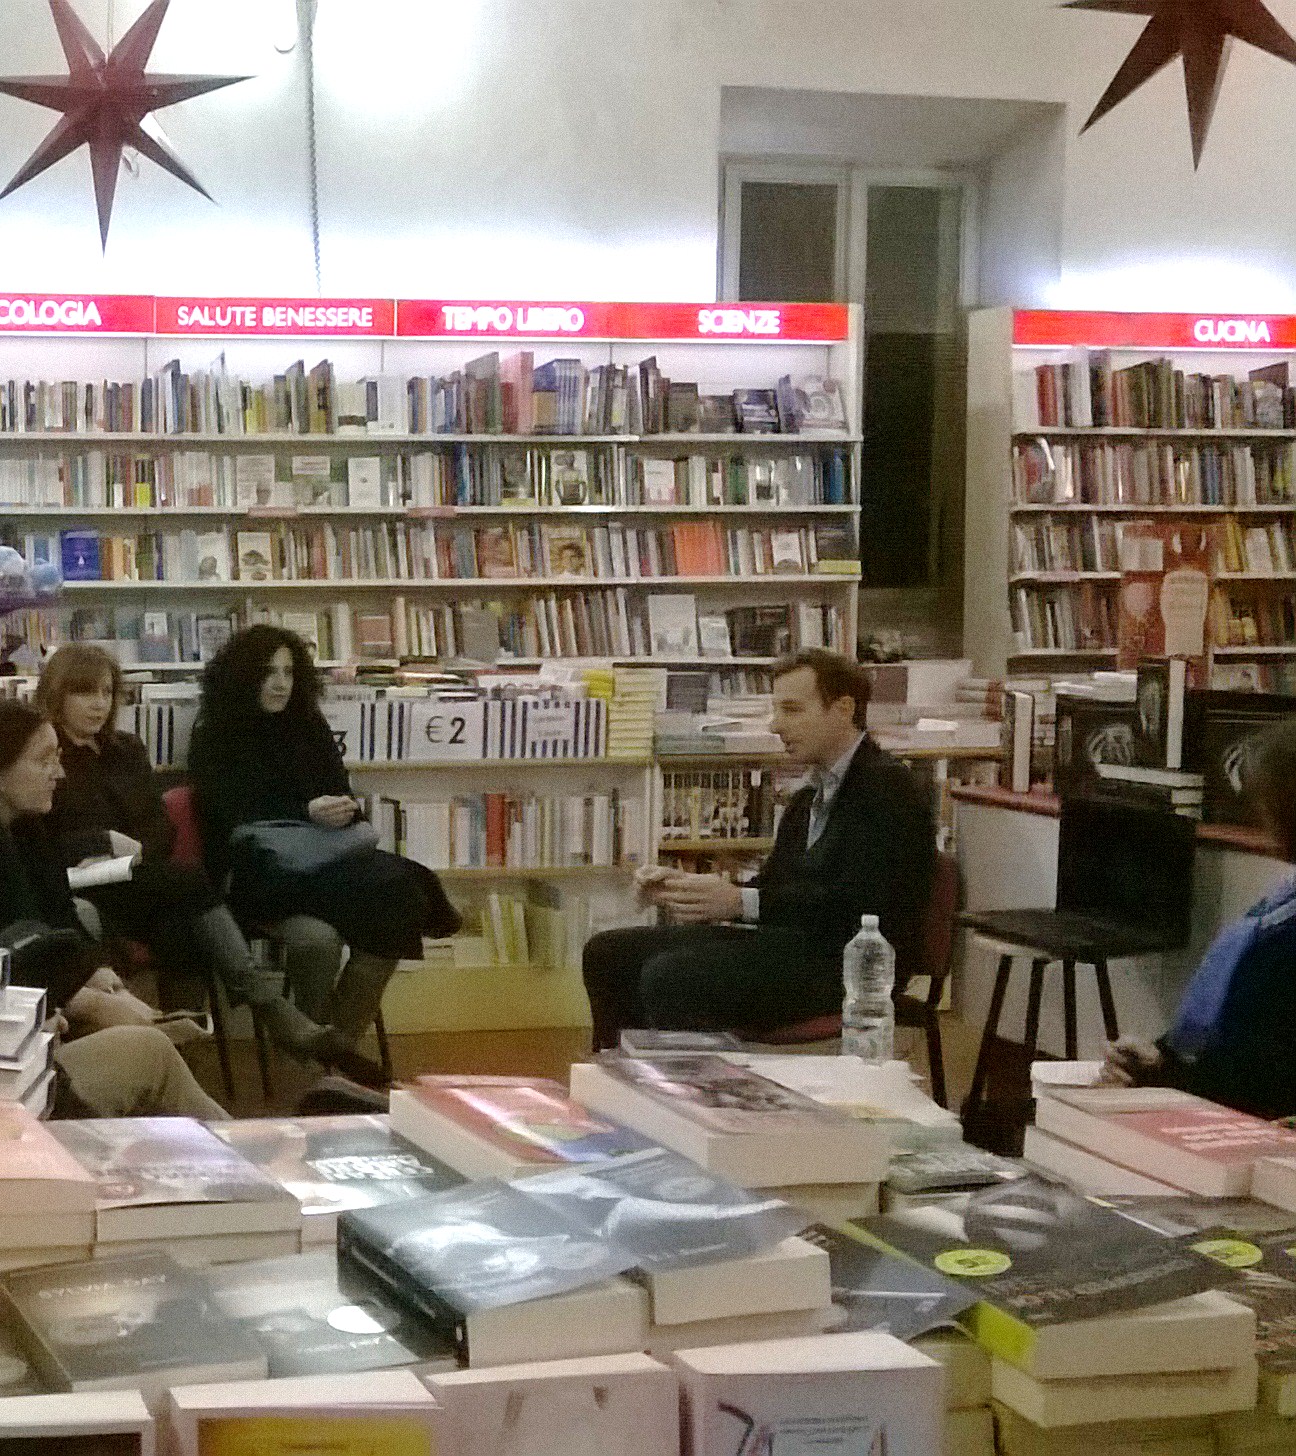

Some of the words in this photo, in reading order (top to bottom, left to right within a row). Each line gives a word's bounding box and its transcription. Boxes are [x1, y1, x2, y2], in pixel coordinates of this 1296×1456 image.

[177, 305, 257, 327] SALUTE
[262, 306, 373, 328] BENESSERE
[442, 305, 513, 332] TEMPO
[517, 306, 585, 333] LIBERO
[698, 309, 781, 335] SCIENZE
[1194, 319, 1271, 342] CUCINA
